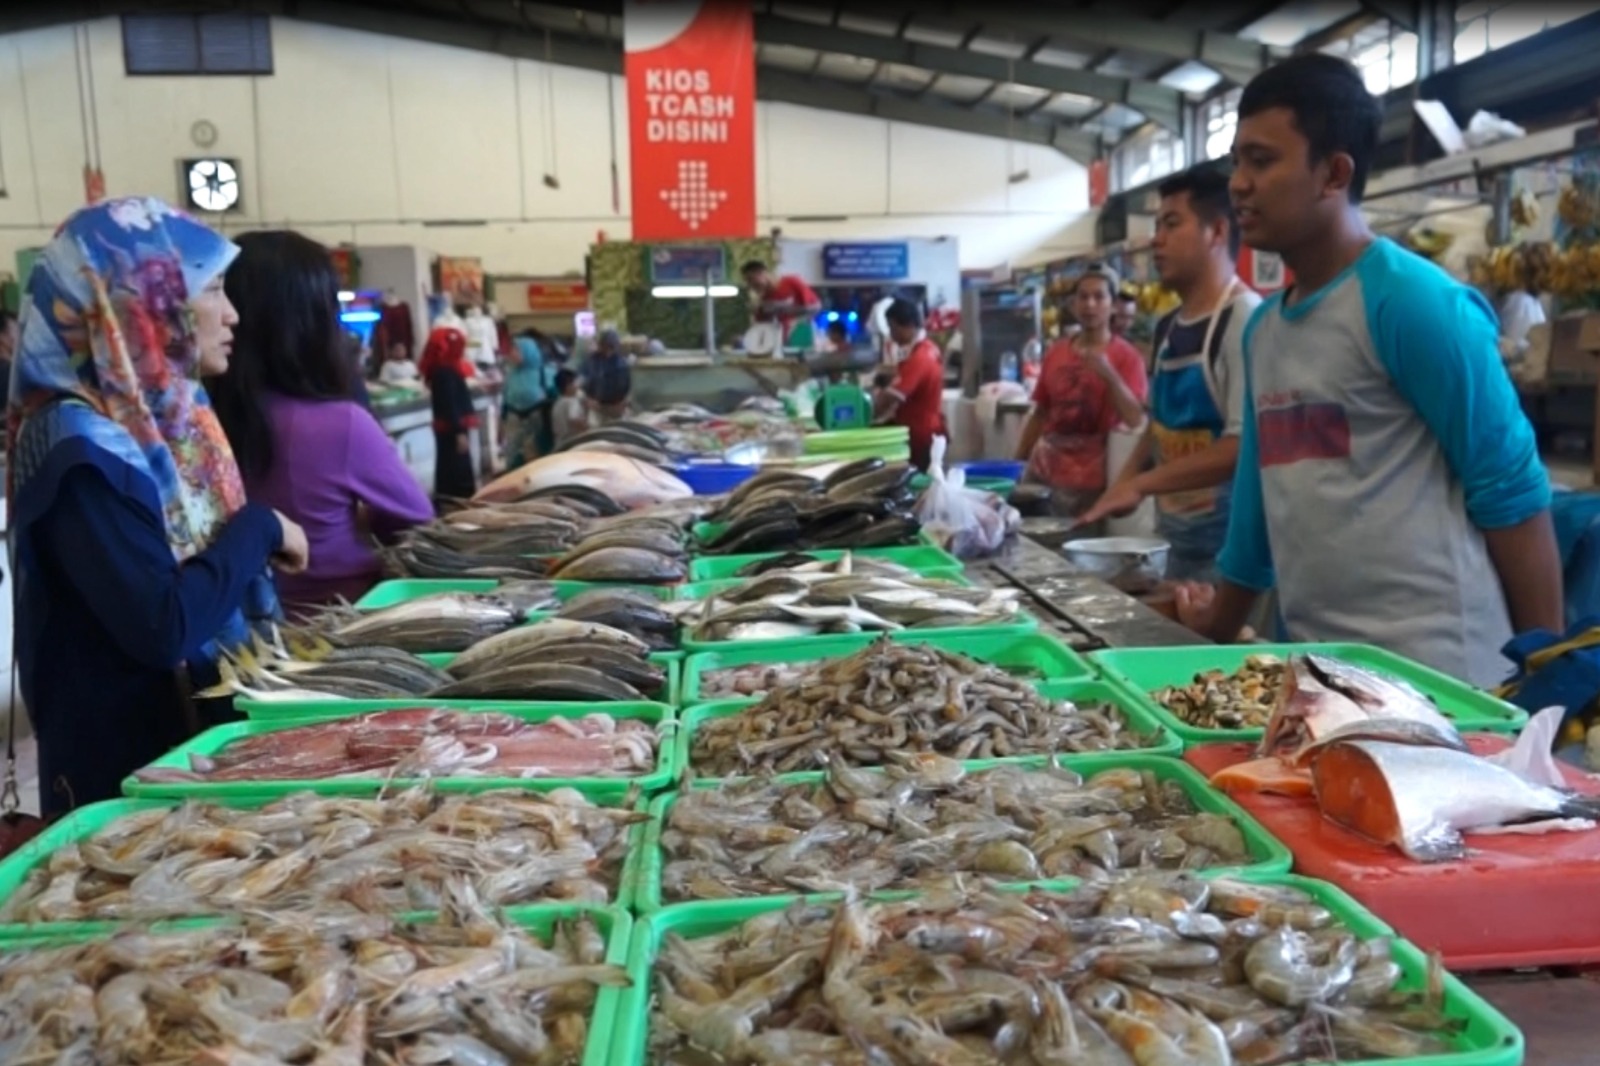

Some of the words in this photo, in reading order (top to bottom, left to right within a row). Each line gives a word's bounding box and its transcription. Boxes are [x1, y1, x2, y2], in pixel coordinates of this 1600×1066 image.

[646, 69, 710, 92] KIOS
[646, 94, 734, 118] TCASH
[647, 119, 728, 142] DISINI
